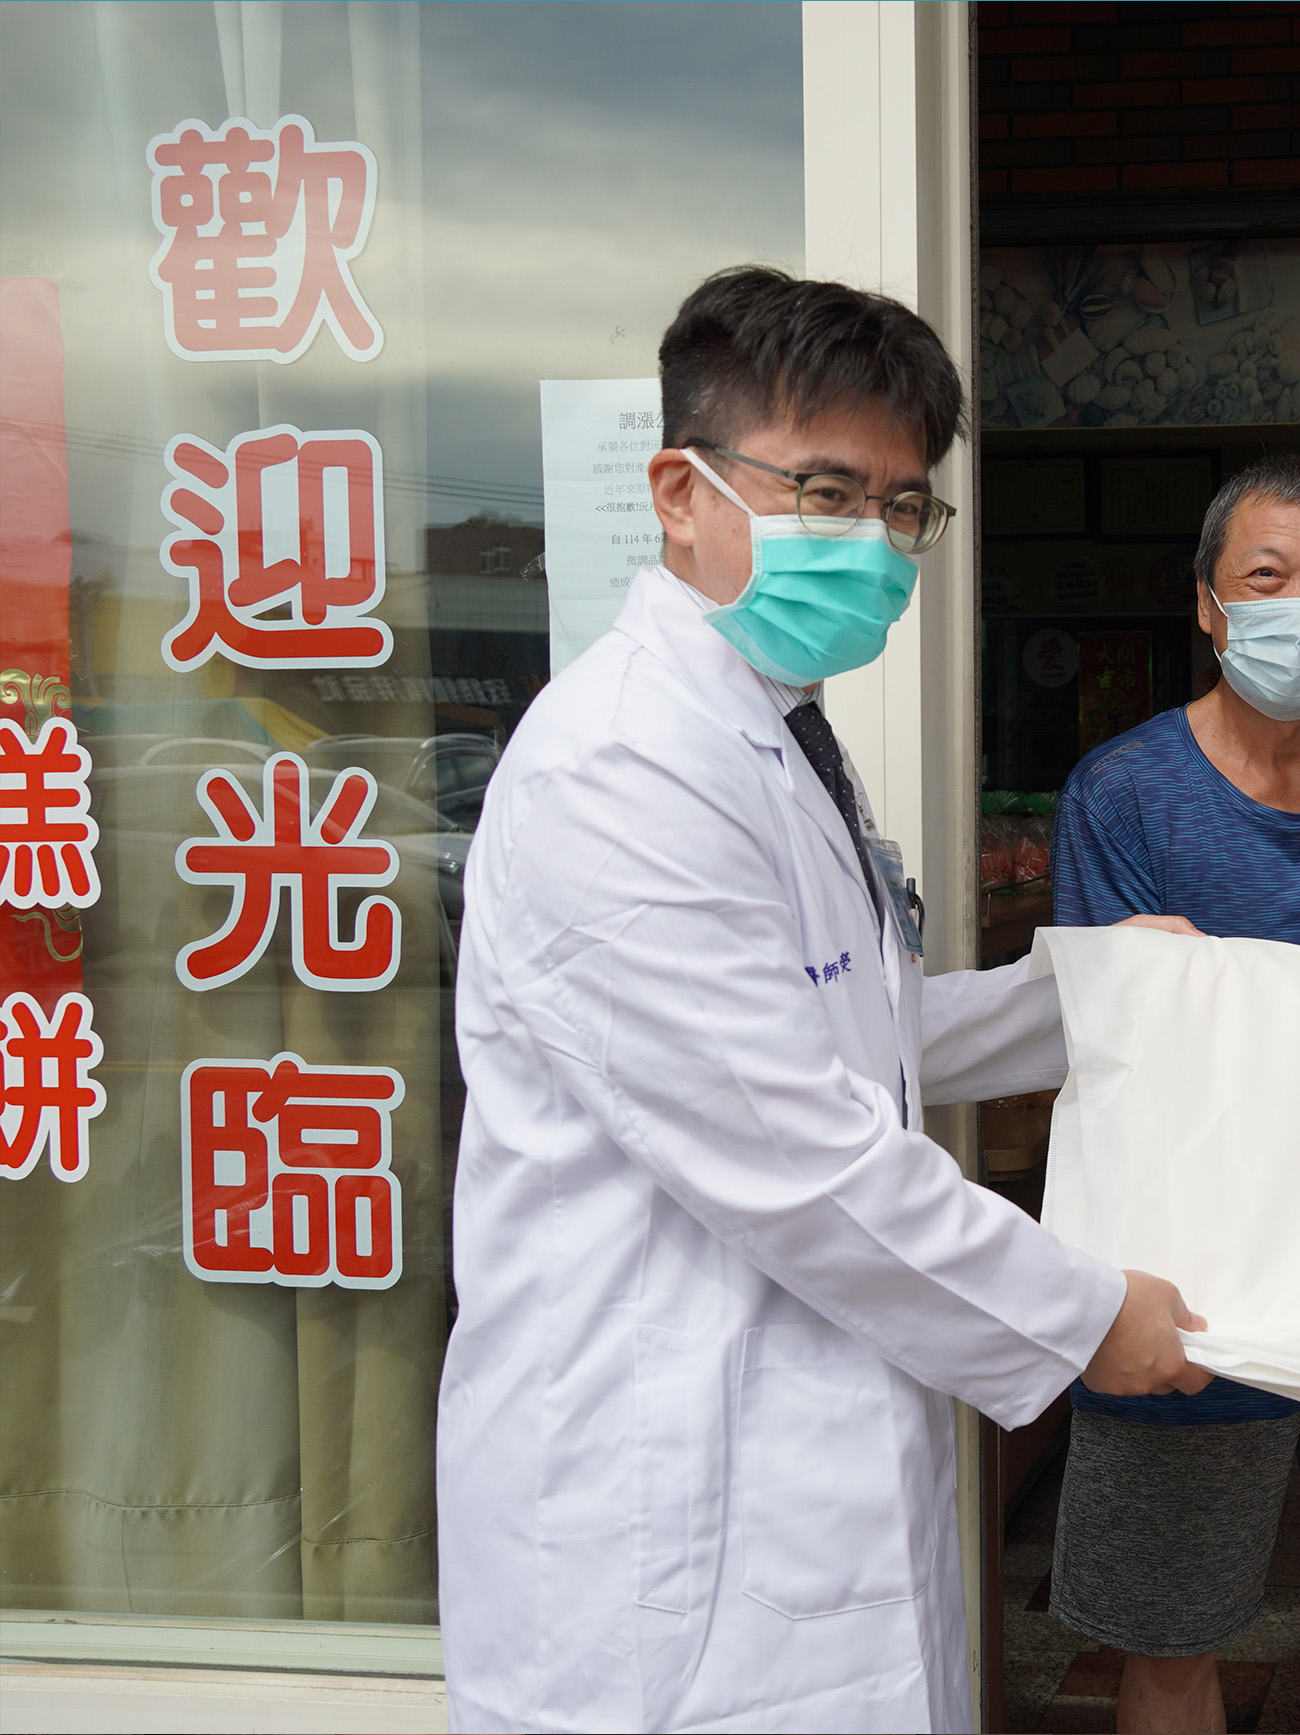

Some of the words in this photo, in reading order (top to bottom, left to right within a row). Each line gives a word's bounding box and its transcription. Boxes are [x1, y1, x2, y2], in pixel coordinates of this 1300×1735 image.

[147, 114, 406, 1290] 歡迎光臨
[611, 534, 621, 545] 自
[624, 535, 640, 545] 114
[642, 533, 653, 545] 年
